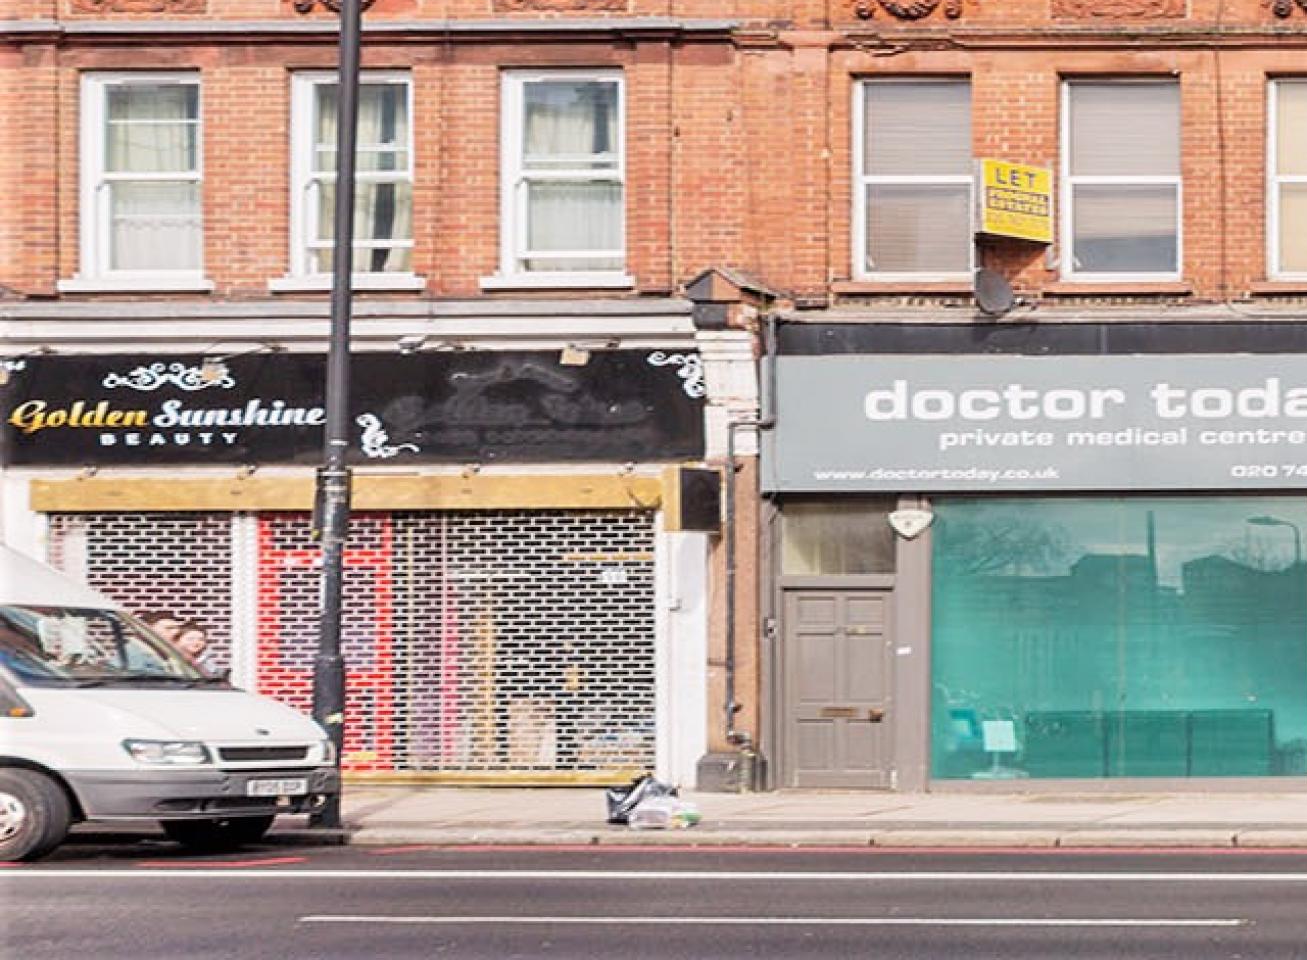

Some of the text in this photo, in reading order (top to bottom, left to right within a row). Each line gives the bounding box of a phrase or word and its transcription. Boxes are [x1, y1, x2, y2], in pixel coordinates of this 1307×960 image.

[995, 167, 1035, 188] LET
[864, 379, 1126, 421] doctor
[7, 398, 327, 434] Golden Sunshine
[100, 433, 239, 446] BEAUTY
[939, 427, 1306, 450] private medical centre
[814, 467, 1061, 483] www.doctortoday.co.uk
[1231, 464, 1278, 478] 020
